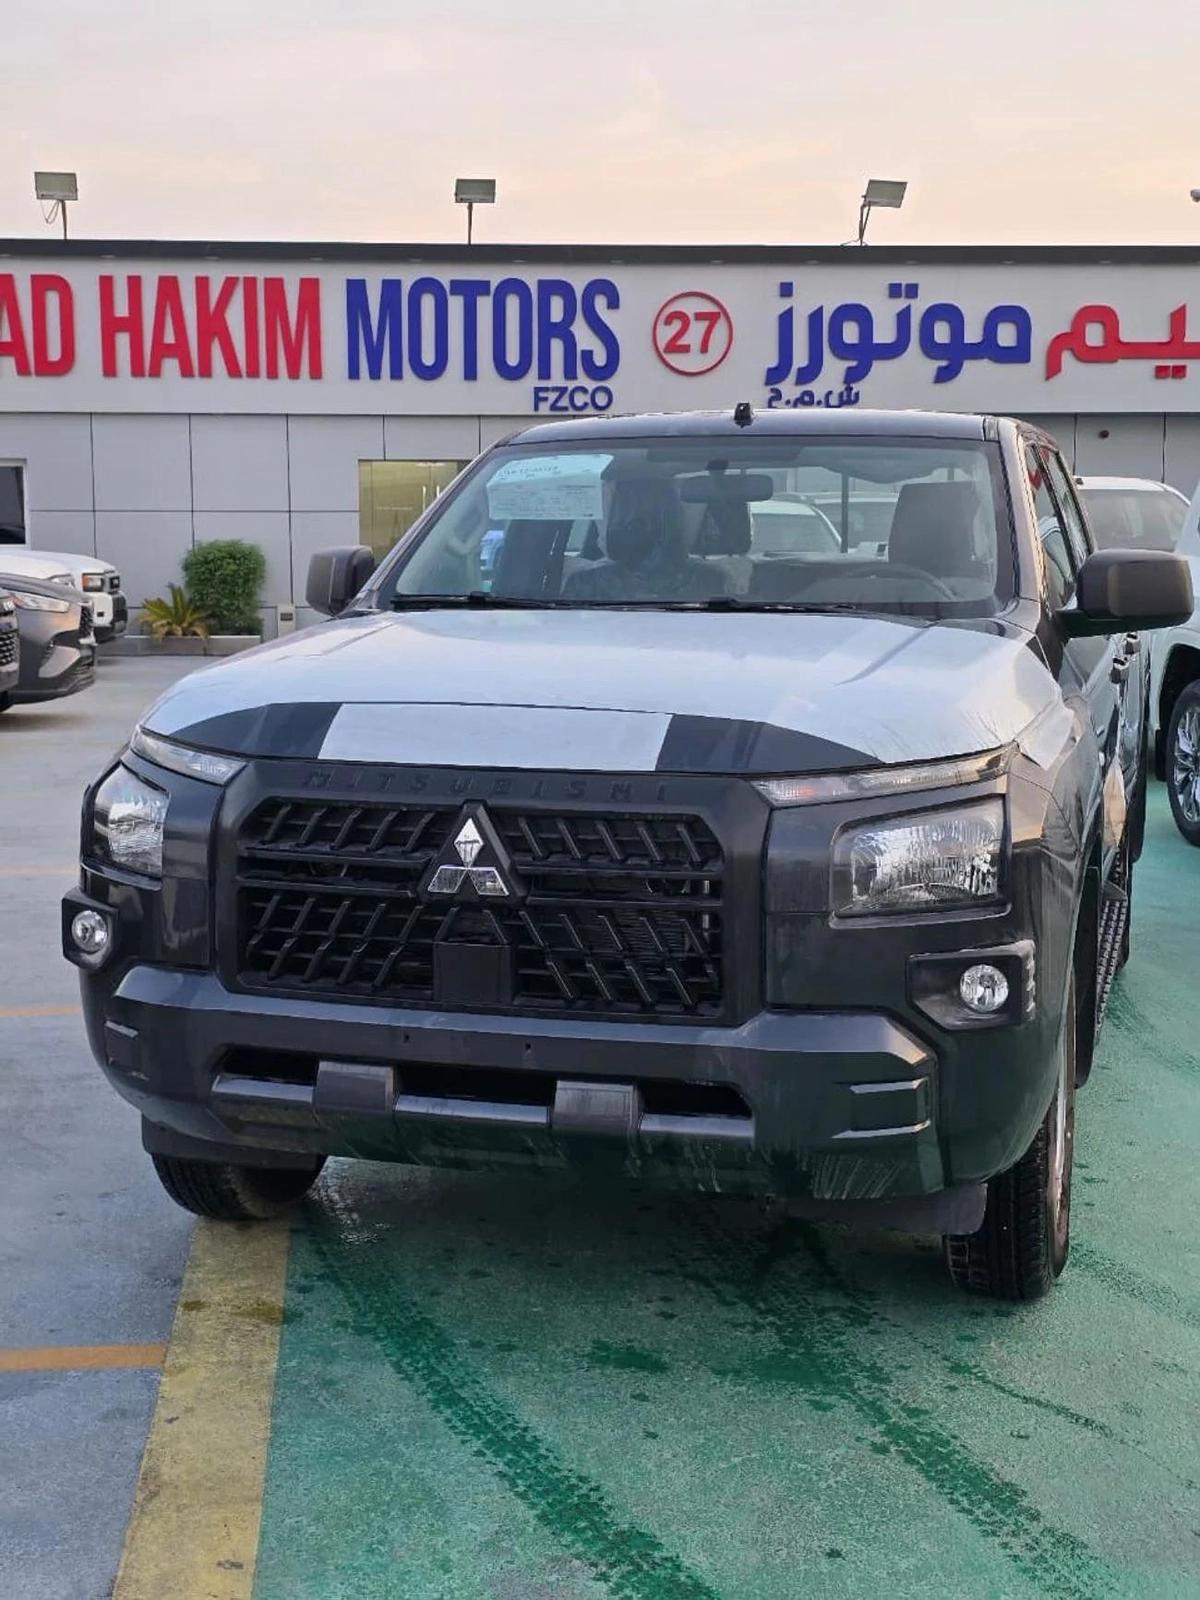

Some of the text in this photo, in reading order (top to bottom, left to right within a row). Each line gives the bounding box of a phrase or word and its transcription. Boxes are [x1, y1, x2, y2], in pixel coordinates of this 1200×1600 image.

[98, 275, 323, 380] HAKIM
[346, 277, 621, 382] MOTORS
[662, 311, 722, 354] 27
[764, 282, 1200, 386] يم موتورز
[532, 386, 614, 412] FZCO
[303, 771, 667, 803] MITSUBISHI
